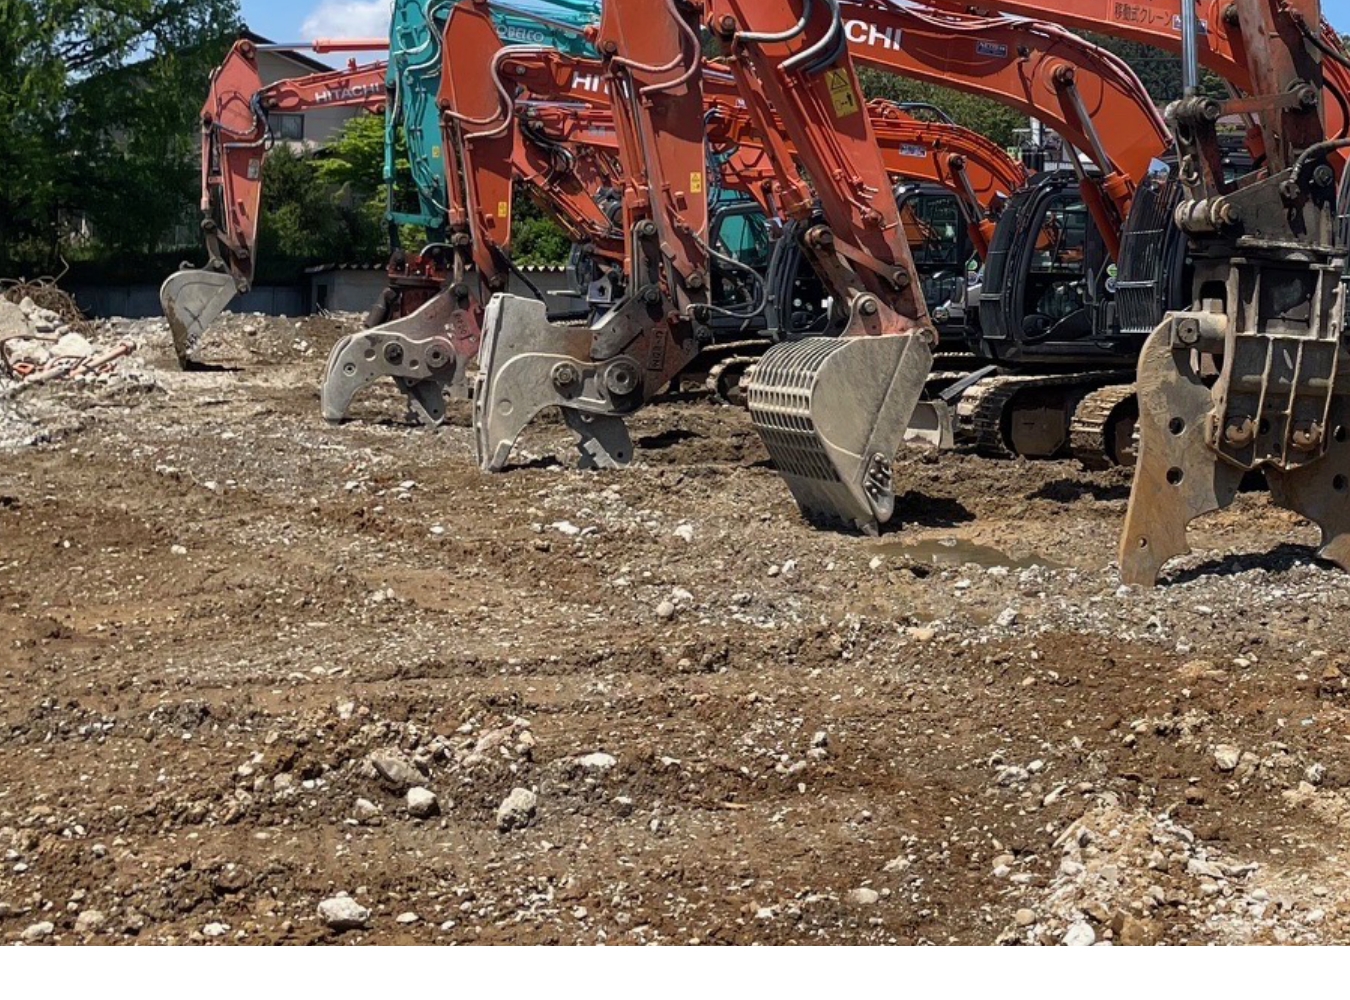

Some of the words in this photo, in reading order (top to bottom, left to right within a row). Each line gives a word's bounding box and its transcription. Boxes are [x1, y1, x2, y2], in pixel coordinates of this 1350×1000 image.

[1114, 2, 1173, 26] 移動式クレーン
[496, 24, 544, 42] OBELCO
[842, 18, 902, 51] CHI
[314, 82, 379, 103] HITACHI
